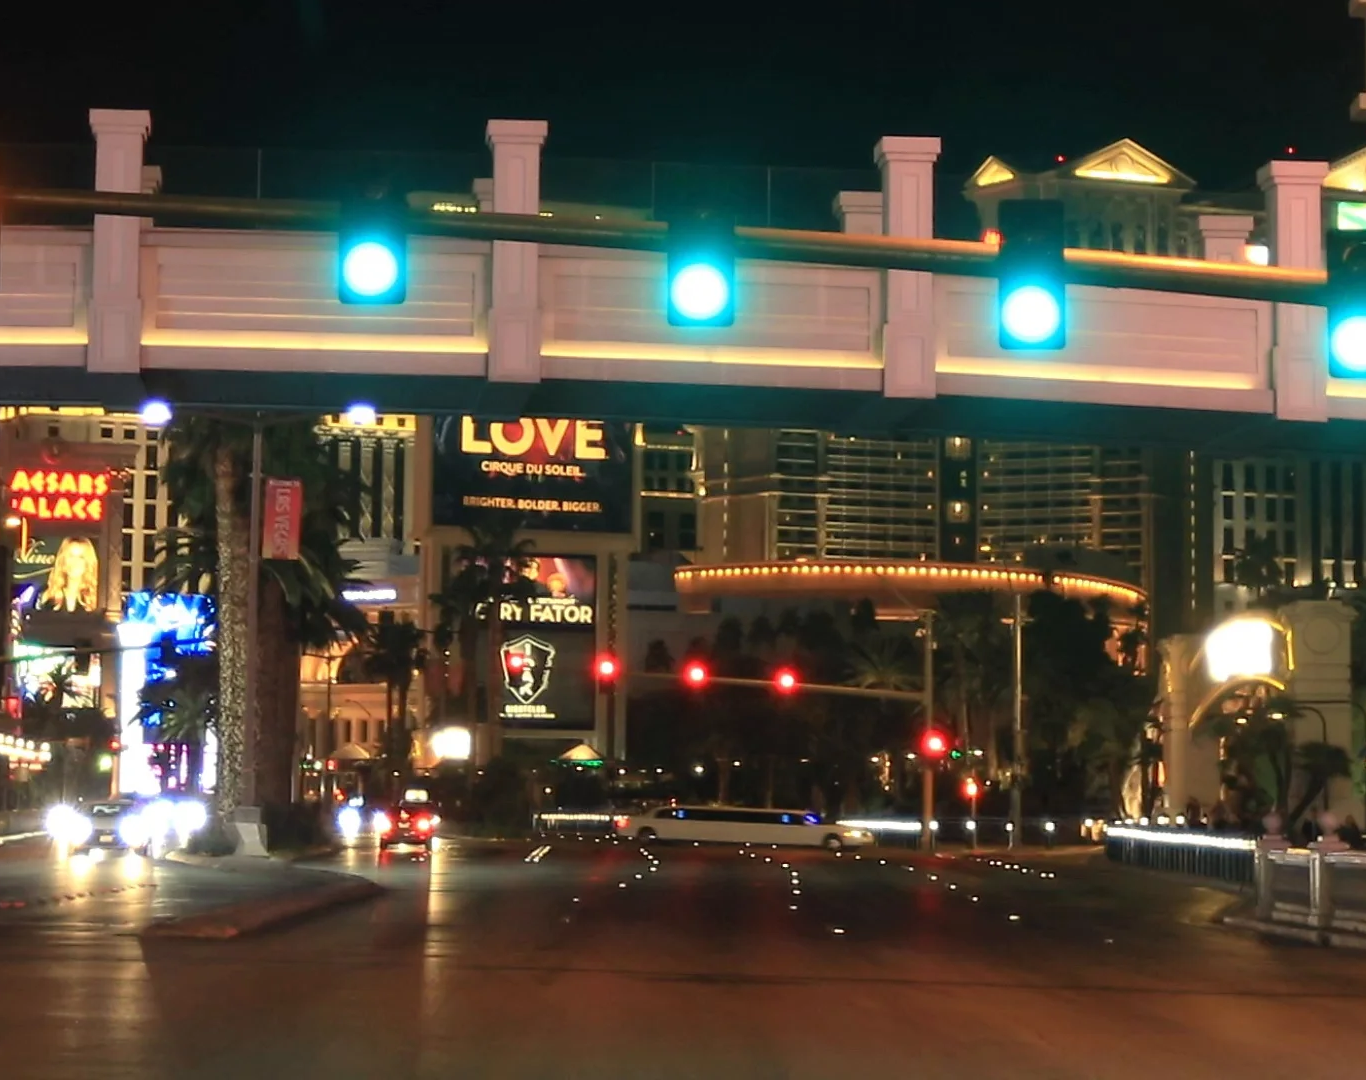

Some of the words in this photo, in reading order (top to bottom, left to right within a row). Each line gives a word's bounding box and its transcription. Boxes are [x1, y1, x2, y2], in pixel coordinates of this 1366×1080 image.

[461, 415, 606, 459] LOVE
[481, 460, 524, 476] CIRQUE
[526, 463, 543, 475] DU
[11, 470, 108, 495] AESARS
[11, 497, 102, 520] ALACE
[463, 496, 516, 509] BRIGHTER.
[518, 499, 561, 511] BOLDER.
[562, 501, 602, 513] BIGGER.
[530, 604, 593, 624] FATOR
